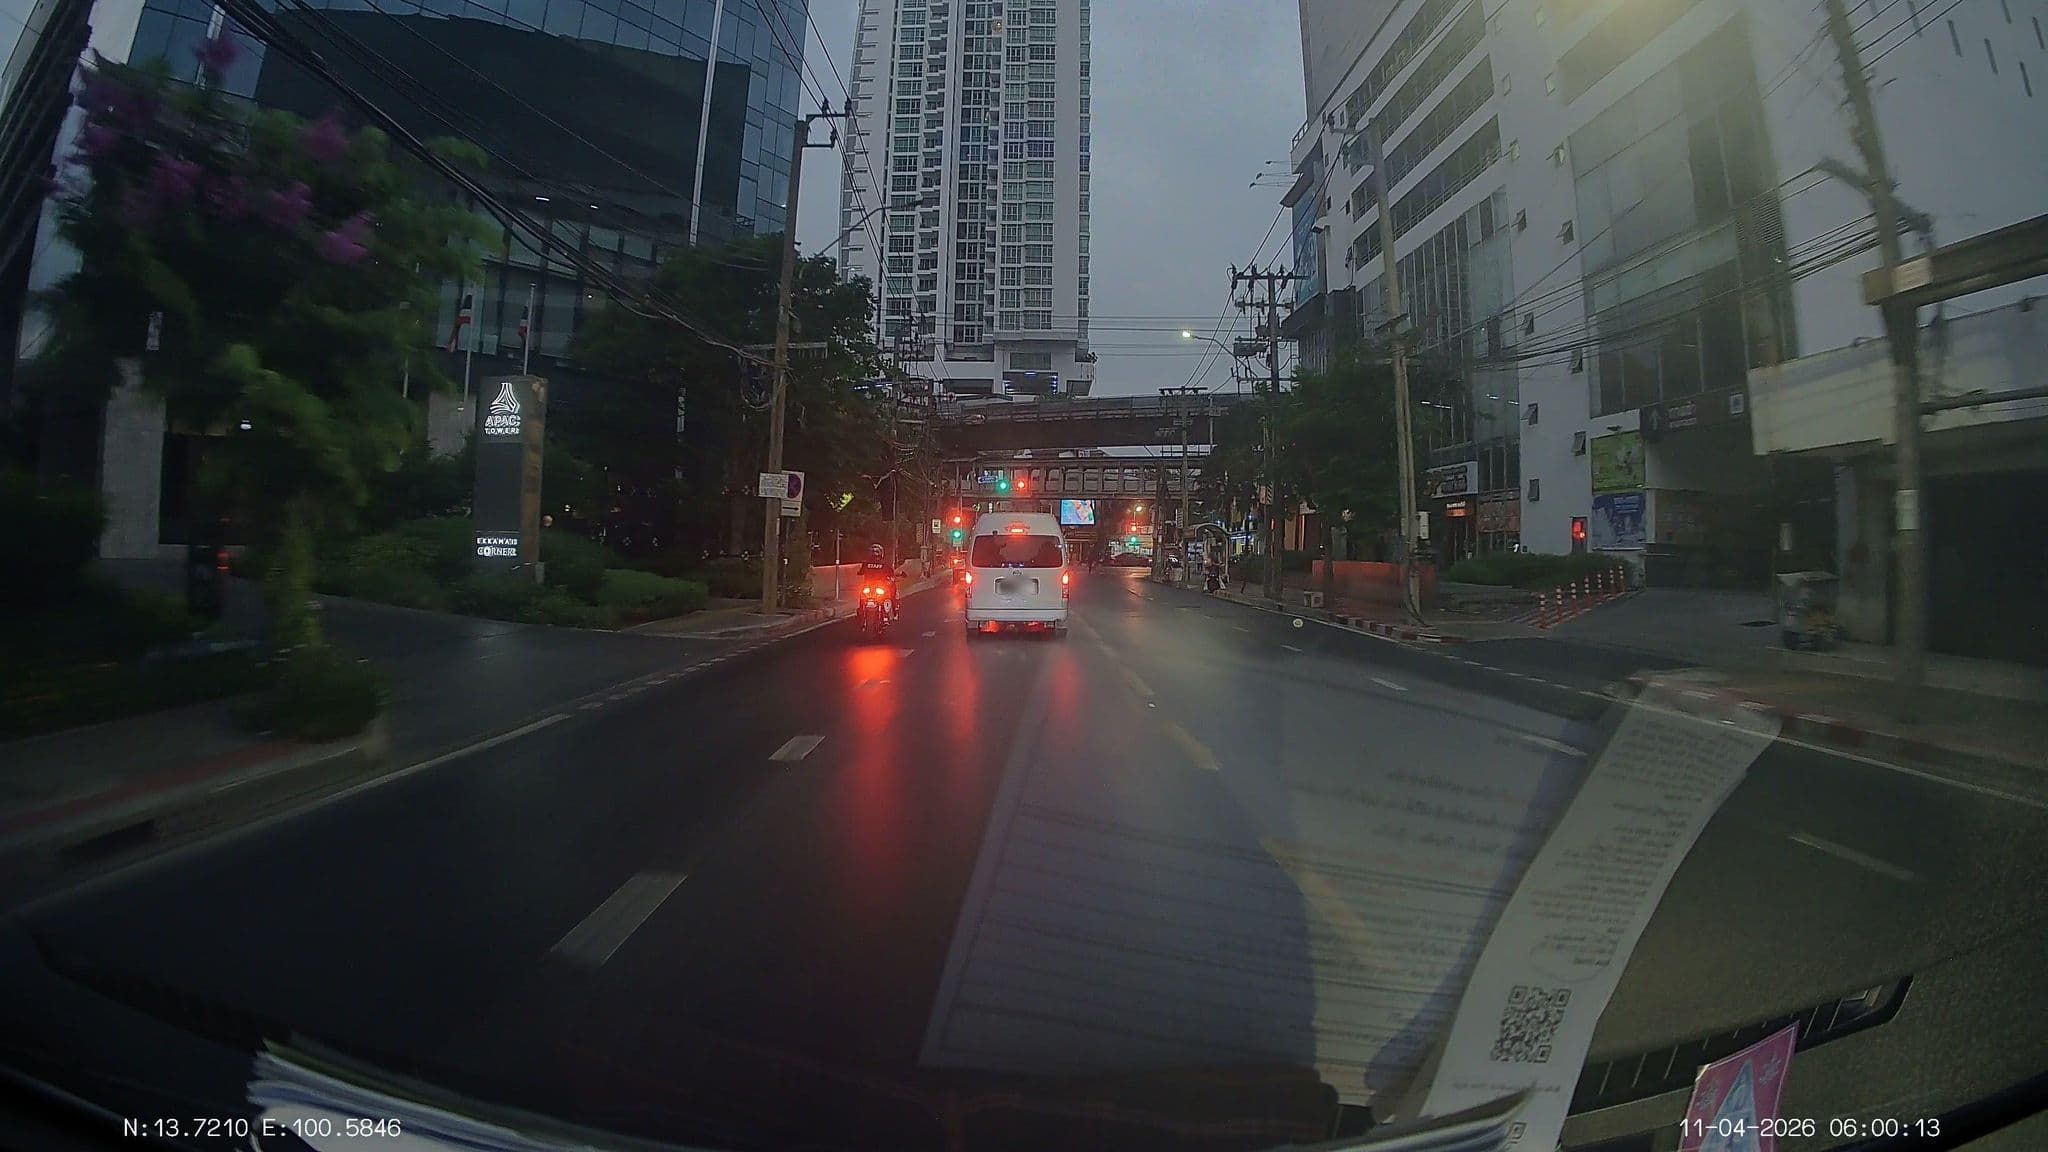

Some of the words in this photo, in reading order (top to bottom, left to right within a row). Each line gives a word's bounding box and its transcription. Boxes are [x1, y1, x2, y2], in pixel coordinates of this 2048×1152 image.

[484, 415, 520, 427] APAC
[476, 537, 518, 545] EKKAMAI
[477, 546, 517, 557] CORNER
